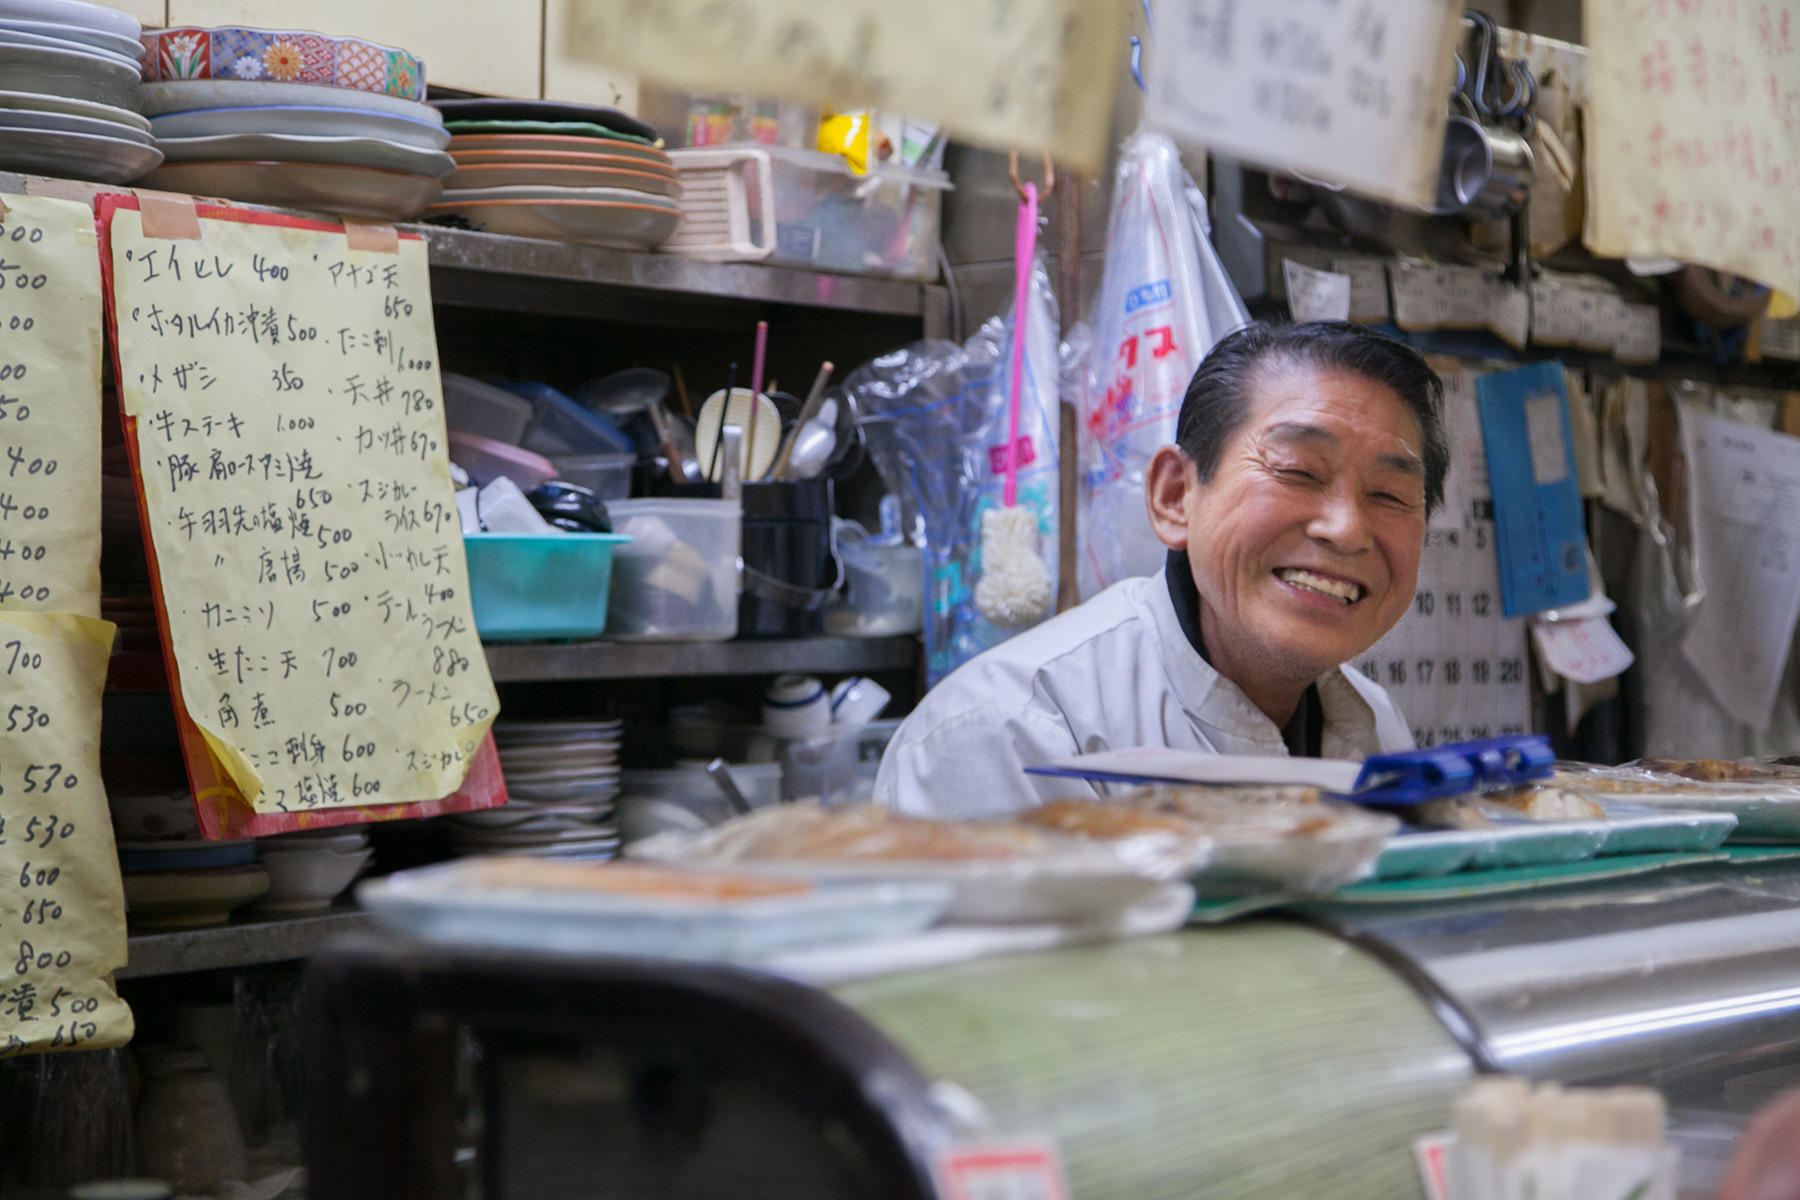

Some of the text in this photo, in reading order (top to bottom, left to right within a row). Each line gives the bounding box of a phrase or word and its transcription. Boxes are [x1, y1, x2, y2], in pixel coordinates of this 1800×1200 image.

[252, 253, 290, 282] 400
[384, 296, 413, 319] 650
[287, 314, 318, 341] 500
[272, 363, 304, 391] 350
[401, 389, 434, 416] 780
[156, 409, 244, 442] 牛ステーキ
[410, 430, 437, 462] 670
[7, 446, 58, 477] 400
[0, 492, 49, 520] 400
[296, 487, 333, 509] 650
[423, 500, 451, 534] 670
[317, 524, 352, 549] 500
[325, 560, 359, 582] 500
[424, 583, 455, 605] 400
[1417, 592, 1490, 617] 10 11 12
[312, 599, 351, 622] 500
[5, 640, 42, 675] 700
[322, 647, 358, 678] 700
[1389, 660, 1407, 683] 16
[1417, 660, 1435, 683] 17
[329, 691, 367, 718] 500
[450, 702, 489, 727] 650
[6, 704, 50, 733] 530
[342, 733, 376, 762] 600
[352, 772, 381, 797] 600
[24, 815, 75, 848] 530
[20, 861, 60, 888] 600
[22, 898, 63, 925] 650
[15, 940, 72, 975] 800
[51, 986, 98, 1018] 500
